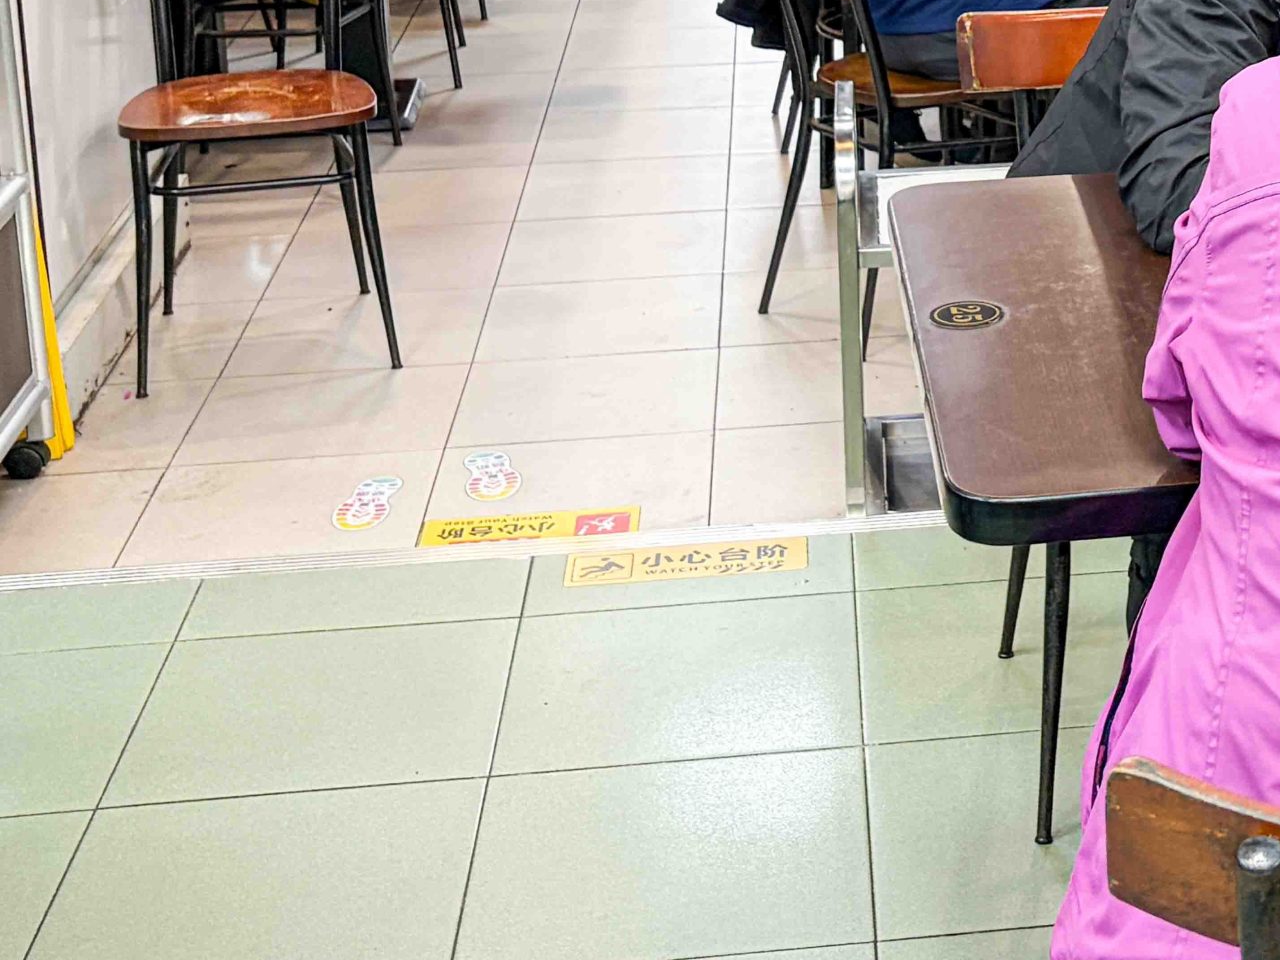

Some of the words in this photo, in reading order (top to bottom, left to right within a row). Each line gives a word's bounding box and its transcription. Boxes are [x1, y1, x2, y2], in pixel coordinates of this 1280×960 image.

[950, 305, 983, 322] 25
[438, 522, 555, 540] 小心台阶
[641, 544, 788, 568] 小心台阶
[645, 566, 698, 575] WATCH
[704, 563, 745, 572] YOUR
